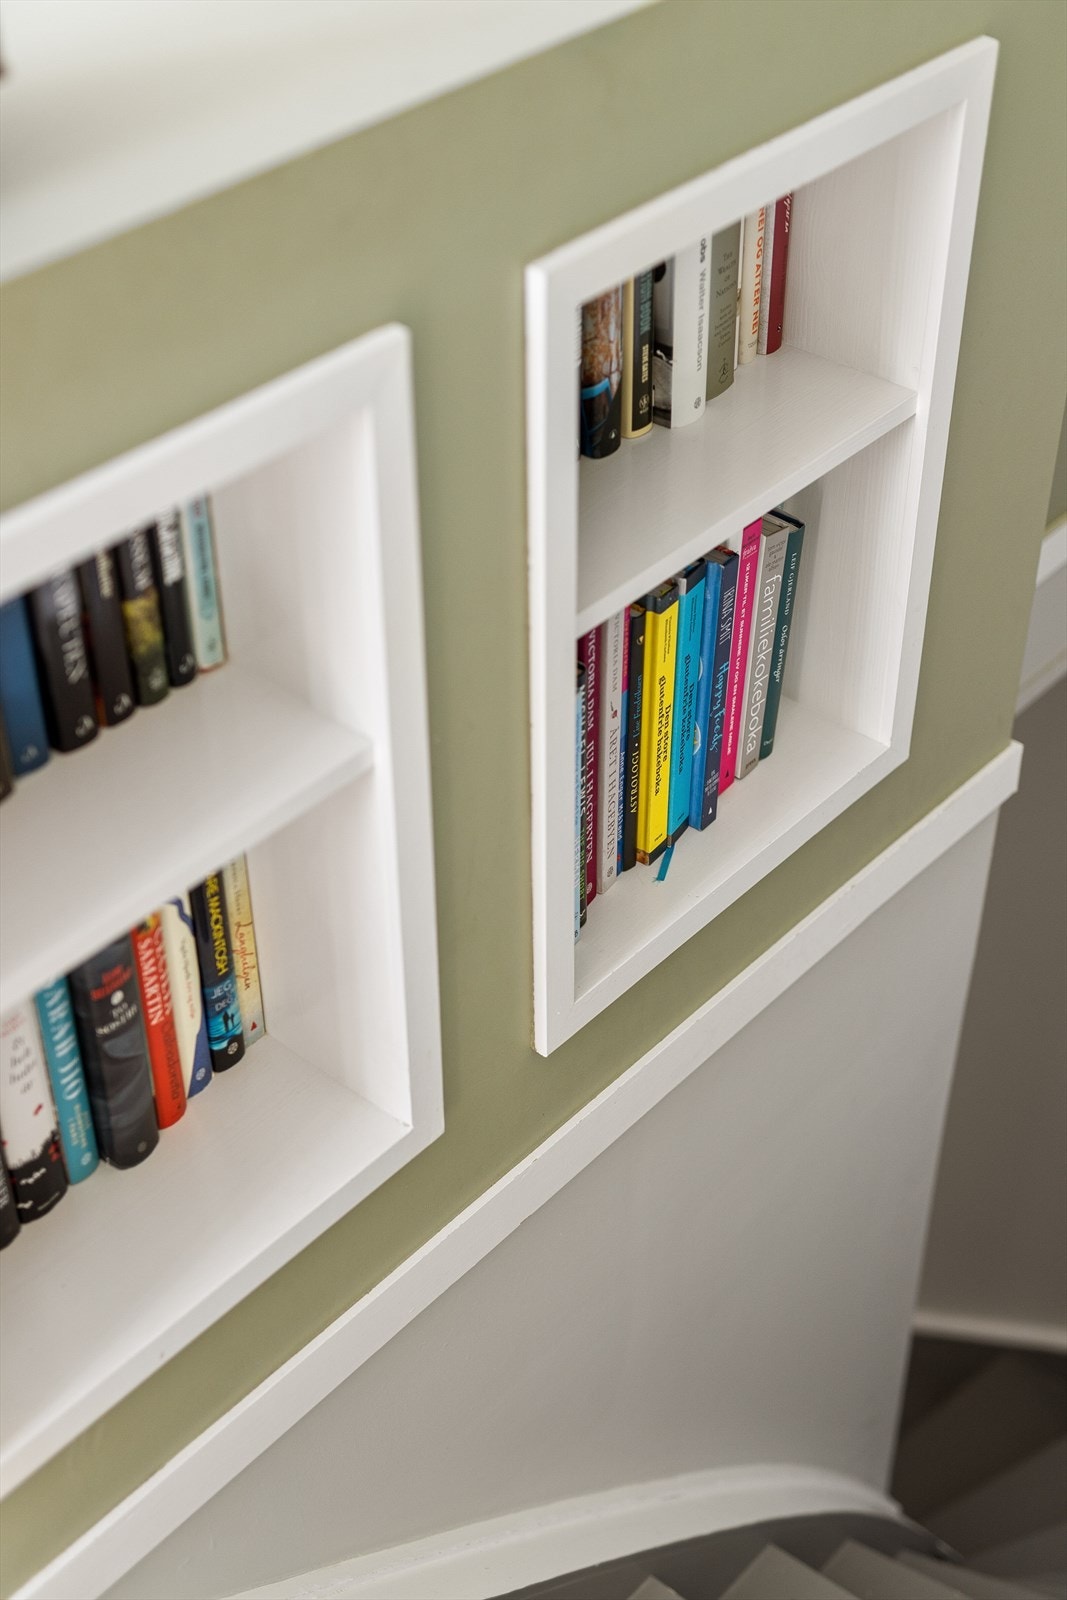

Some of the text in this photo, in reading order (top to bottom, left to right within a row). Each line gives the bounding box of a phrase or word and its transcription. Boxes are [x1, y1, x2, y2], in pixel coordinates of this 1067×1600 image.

[756, 236, 764, 259] OG
[696, 237, 707, 372] obs Walter Isaacson
[753, 263, 762, 306] ATTER
[751, 310, 760, 335] NEI
[790, 552, 798, 572] LEIF
[719, 586, 735, 645] IRINA SMIT
[740, 608, 746, 618] ET
[784, 572, 795, 616] GJERLAND
[736, 619, 745, 657] SUNNERE
[780, 624, 788, 647] Oslos
[587, 628, 596, 698] VICTORIA
[734, 671, 740, 683] OG
[746, 574, 782, 755] familiekokeboka
[710, 661, 730, 716] Happy
[732, 684, 738, 696] EN
[587, 698, 595, 731] DAM
[654, 675, 666, 796] glutenfrie bakeboka
[662, 703, 672, 762] Den store
[678, 653, 691, 775] glutenfrie kokeboka
[729, 696, 737, 731] SMALERE
[608, 726, 619, 767] ÅRET
[630, 750, 640, 813] ASTROLOGI
[586, 779, 594, 864] HAGEBYEN
[607, 779, 616, 860] HAGEBYEN
[232, 919, 256, 991] Langhelgen
[137, 937, 165, 1026] SAMARTIN
[211, 980, 233, 1000] JEG
[43, 986, 78, 1058] ARAH
